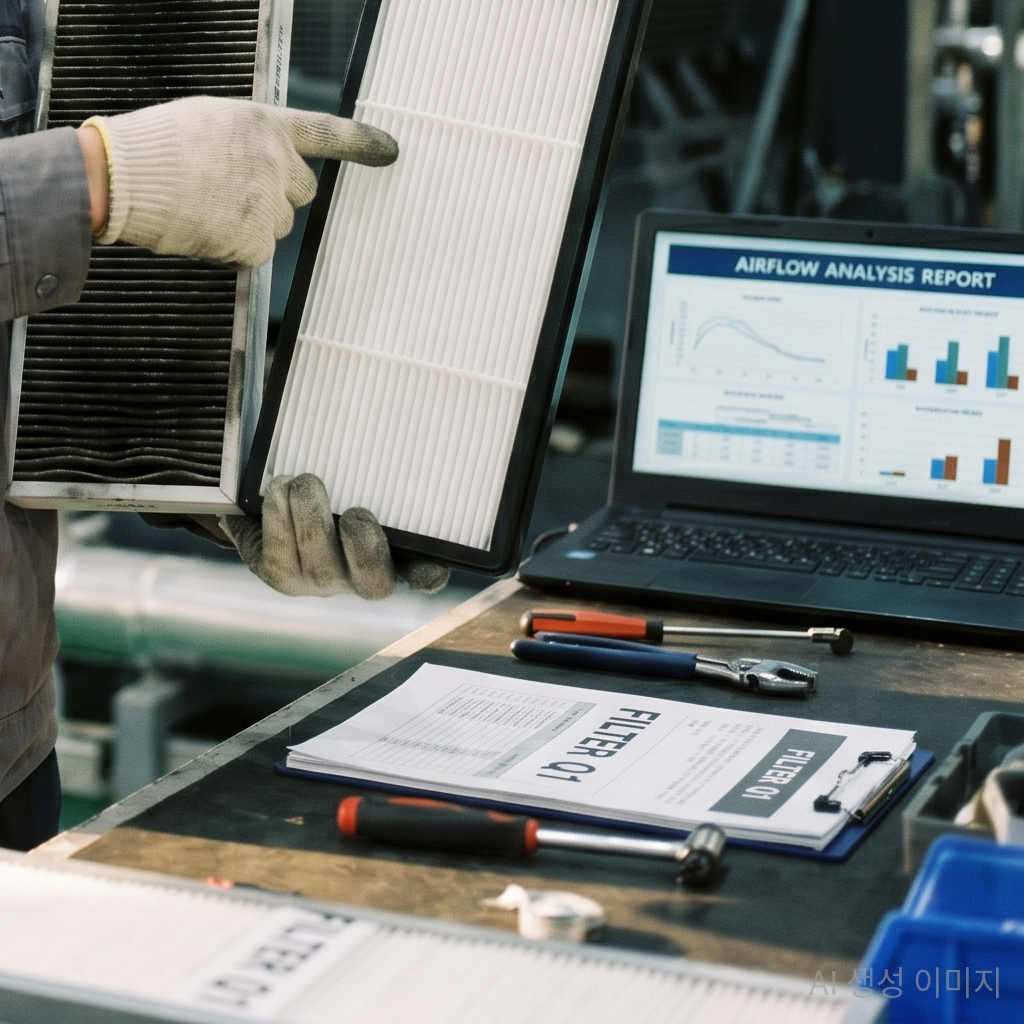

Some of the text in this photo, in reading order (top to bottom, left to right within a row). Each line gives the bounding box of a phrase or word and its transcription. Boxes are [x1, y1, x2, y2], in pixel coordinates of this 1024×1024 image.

[734, 256, 996, 289] AIRFLOW ANALYSIS REPORT
[566, 707, 661, 758] FILTER
[535, 761, 596, 783] Q1
[757, 748, 816, 785] FILTER
